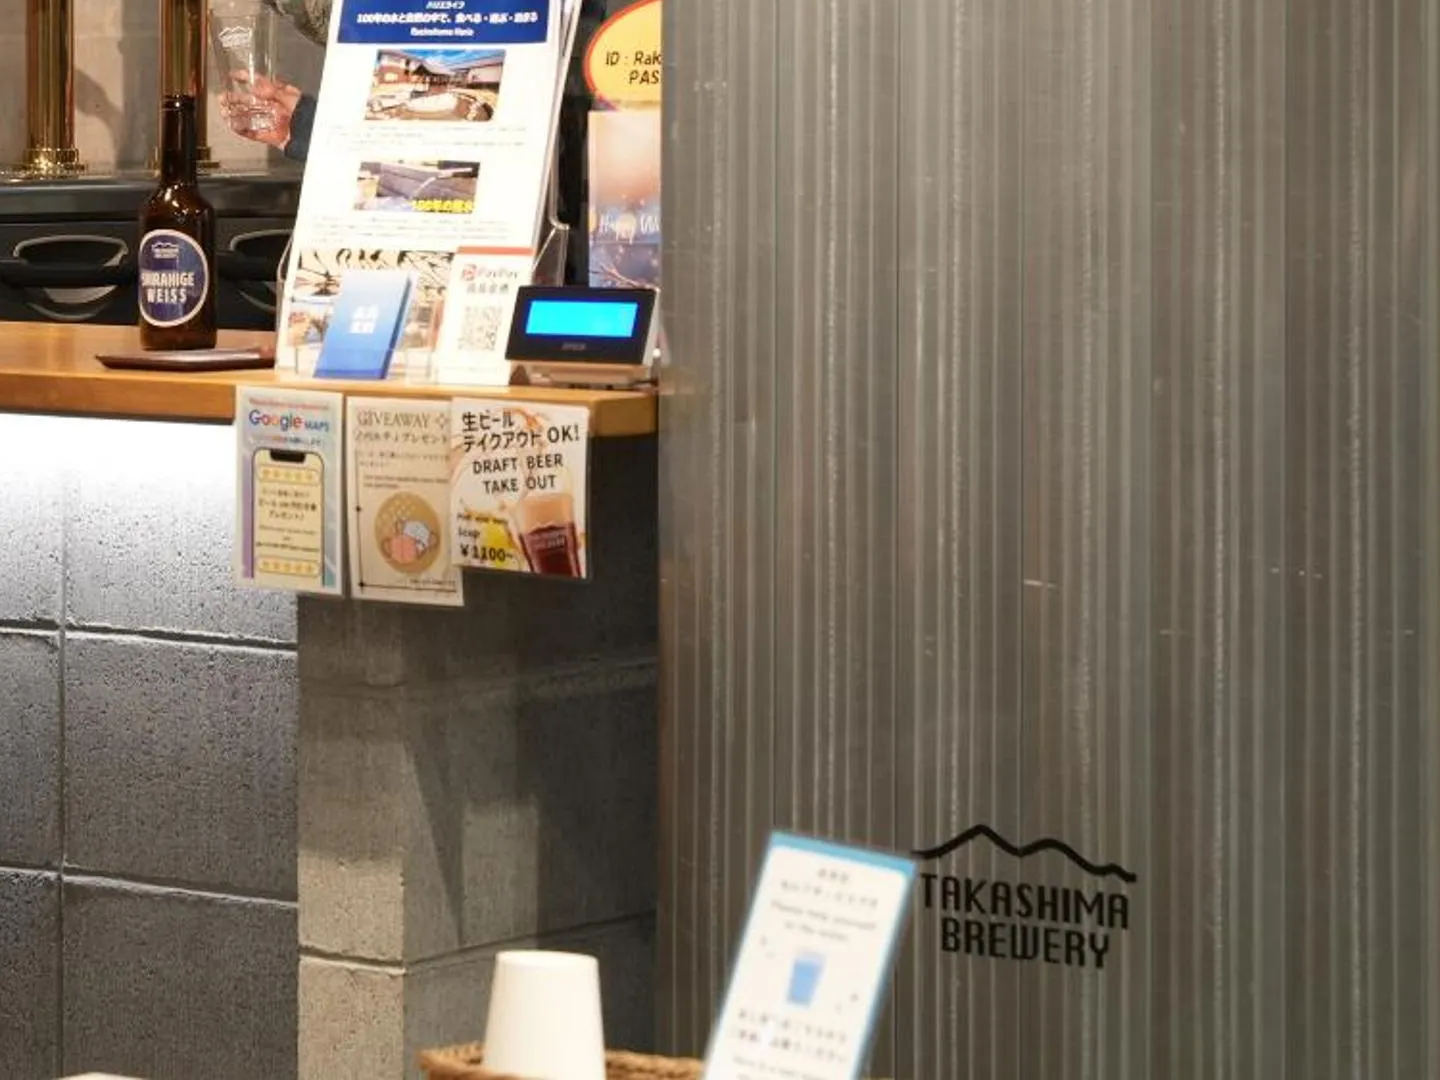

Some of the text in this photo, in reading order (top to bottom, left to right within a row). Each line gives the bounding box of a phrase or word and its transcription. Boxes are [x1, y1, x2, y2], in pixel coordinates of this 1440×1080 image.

[147, 288, 188, 304] WEISS
[249, 409, 302, 432] Google
[357, 408, 430, 428] GIVEAWAY
[462, 409, 515, 432] 生ビール
[472, 453, 563, 474] DRAFT BEER
[483, 475, 557, 494] TAKE OUT
[921, 873, 1129, 929] TAKASHIMA
[941, 919, 1110, 969] BREWERY
